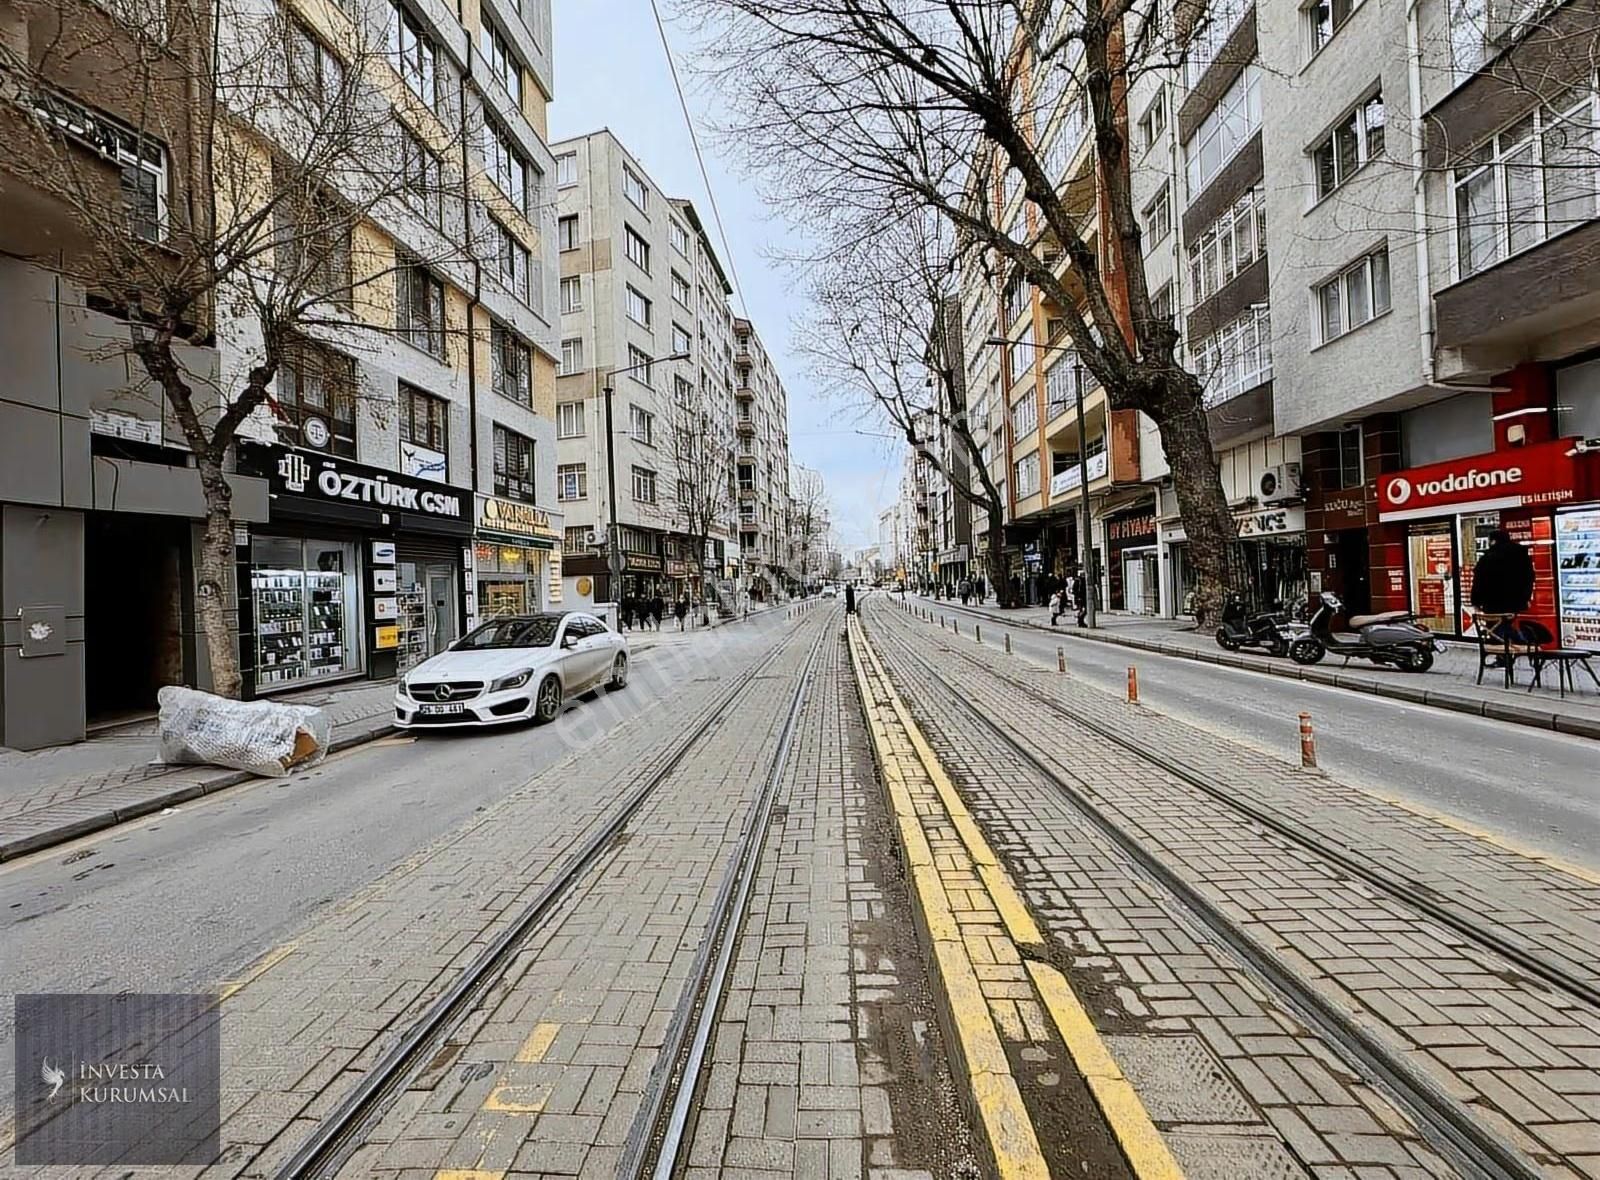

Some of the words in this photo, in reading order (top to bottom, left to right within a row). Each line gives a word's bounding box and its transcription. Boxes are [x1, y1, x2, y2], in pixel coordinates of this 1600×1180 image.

[318, 461, 419, 510] ÖZTÜRK
[420, 491, 460, 517] GSM
[1416, 467, 1523, 497] vodafone
